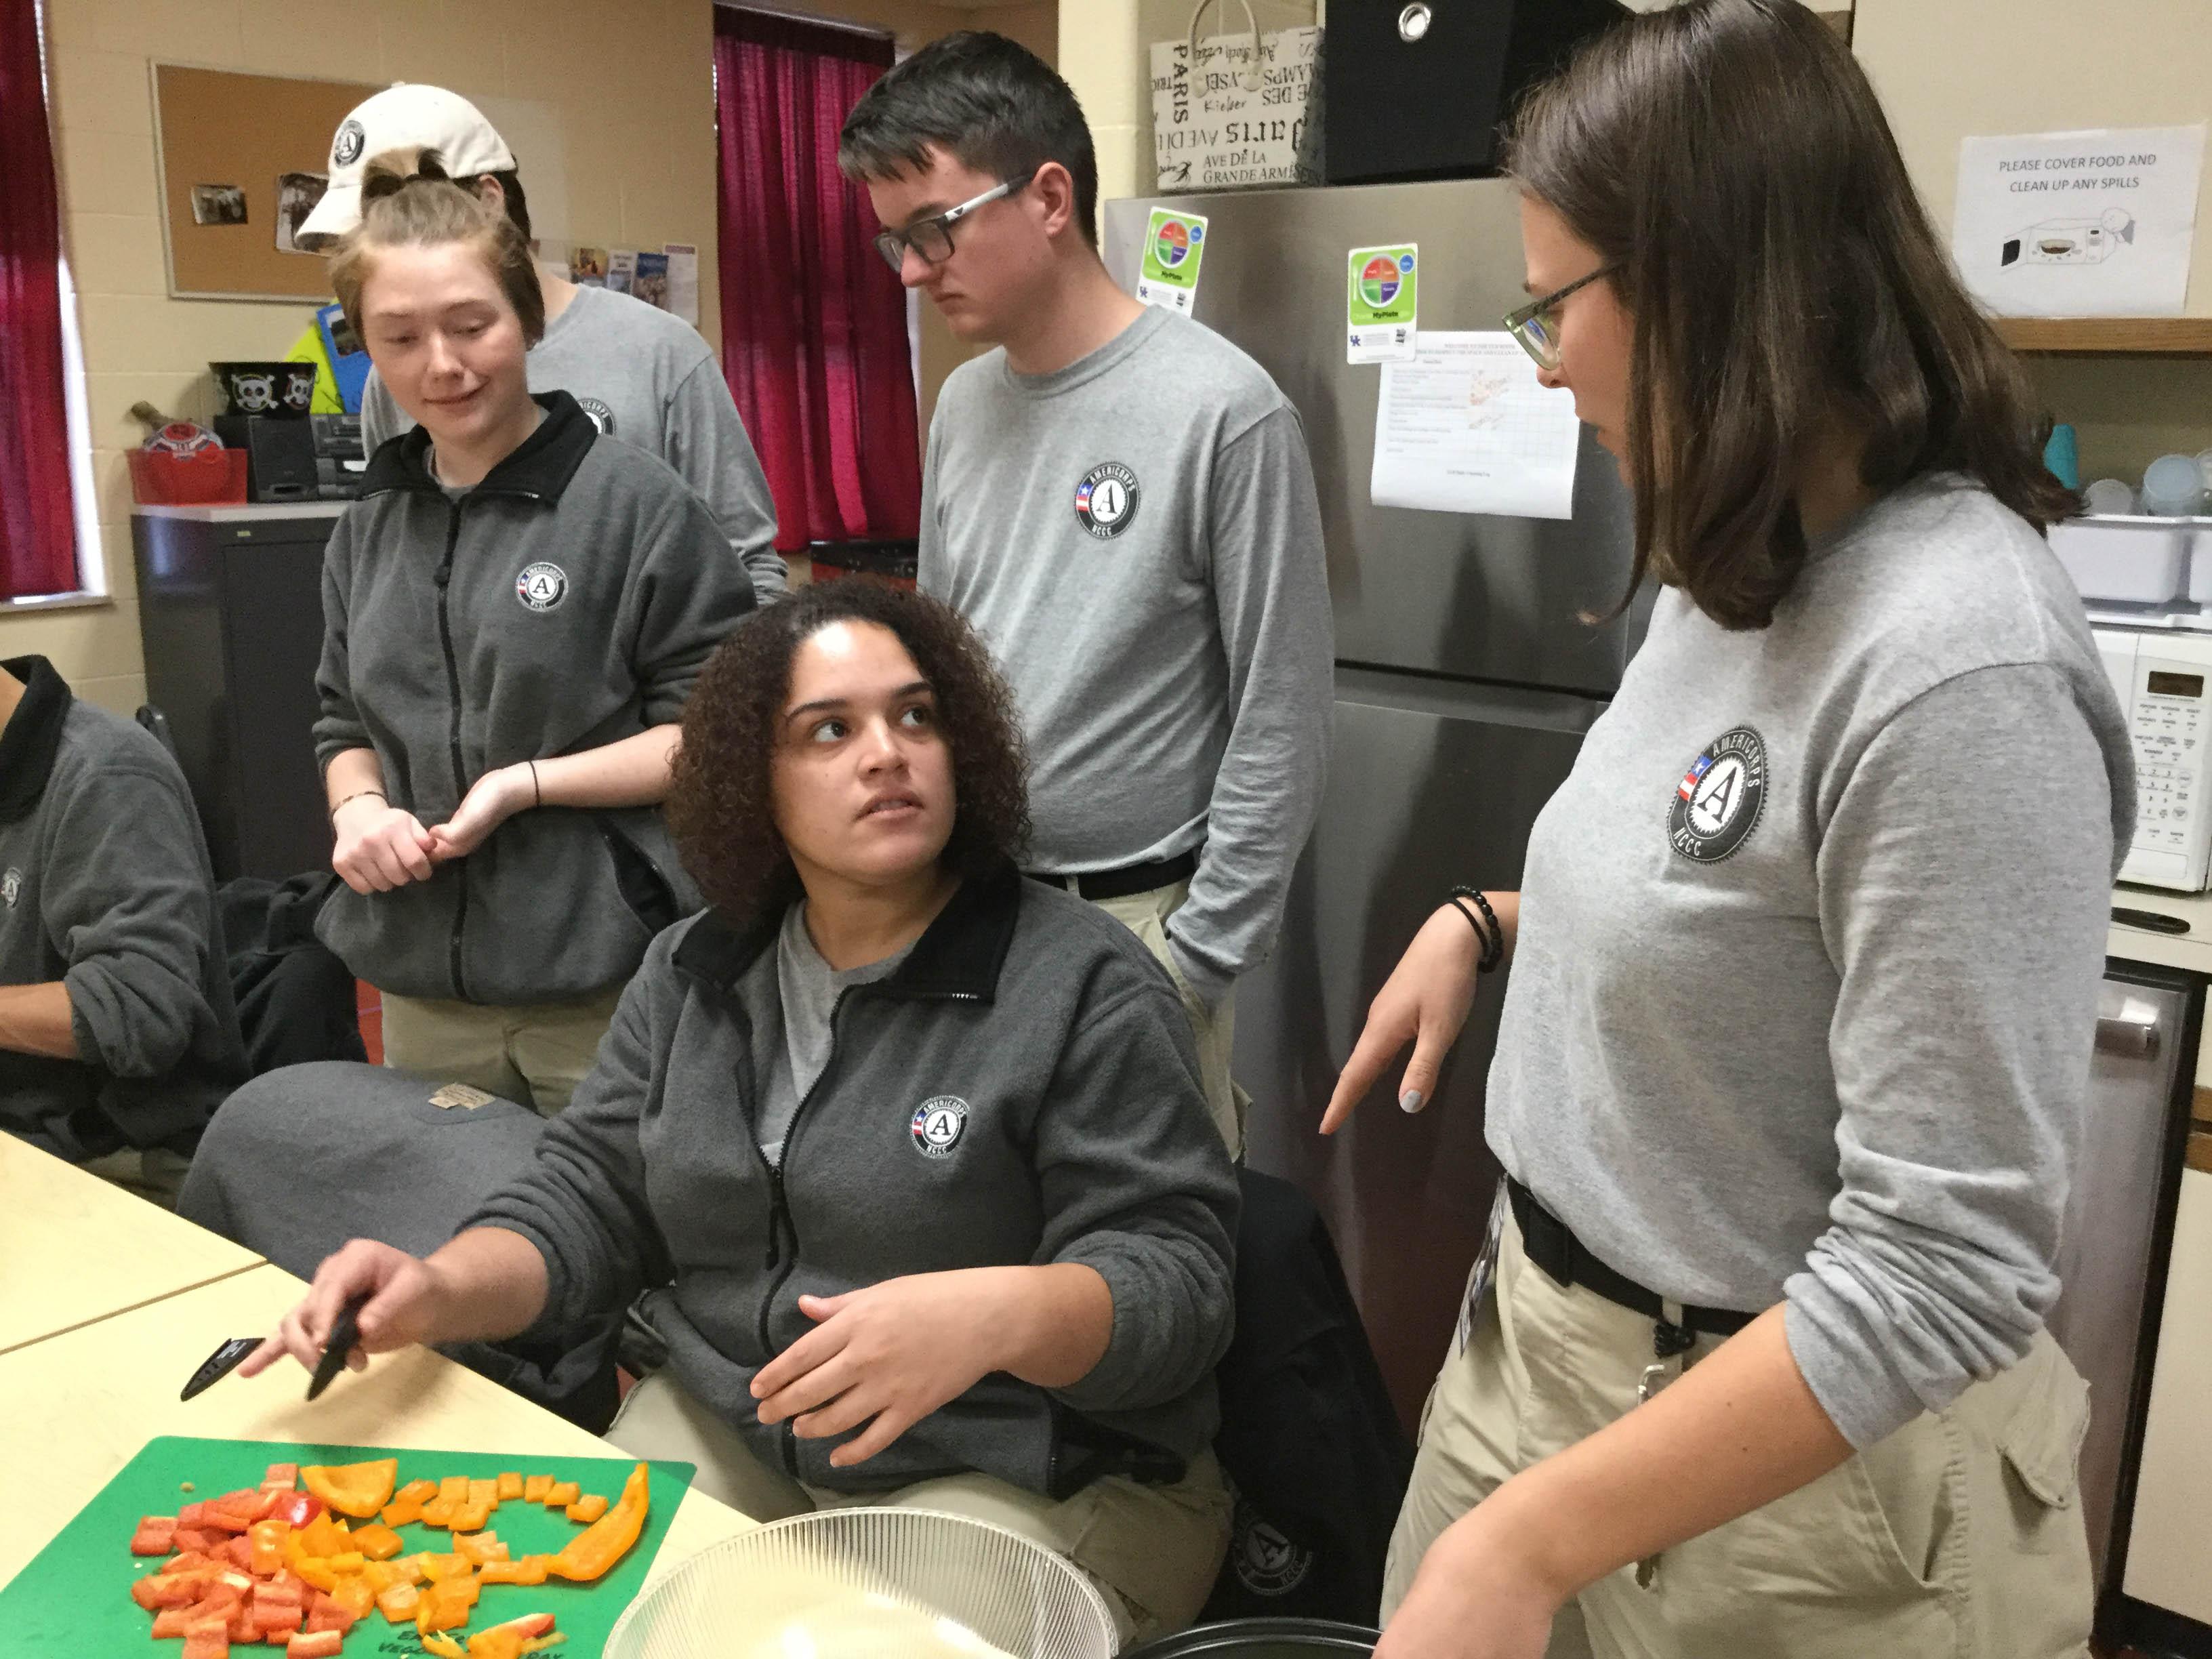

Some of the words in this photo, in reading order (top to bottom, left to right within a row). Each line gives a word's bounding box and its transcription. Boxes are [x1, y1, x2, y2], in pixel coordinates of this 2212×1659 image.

[1173, 44, 1189, 125] PARIS
[1203, 155, 1228, 169] AVE
[1252, 150, 1267, 164] LA
[1999, 159, 2041, 173] PLEASE
[2044, 157, 2086, 170] COVER
[2089, 155, 2125, 168] FOOD
[2129, 154, 2156, 166] AND
[1203, 167, 1256, 184] GRANDE
[2009, 180, 2048, 192] CLEAN
[2051, 180, 2069, 190] UP
[2072, 179, 2098, 190] ANY
[2100, 177, 2140, 190] SPILLS
[1372, 310, 1399, 319] MyPlate
[1089, 466, 1136, 492] AMERICORPS
[1095, 483, 1118, 515] A
[531, 577, 551, 594] A
[1713, 733, 1761, 788] AMERICORPS
[1696, 766, 1738, 825] A
[1673, 827, 1702, 857] NCCC
[923, 1100, 967, 1118] AMERICORPS
[929, 1113, 952, 1136] A
[926, 1145, 947, 1154] NCCC
[1252, 1529, 1288, 1567] A
